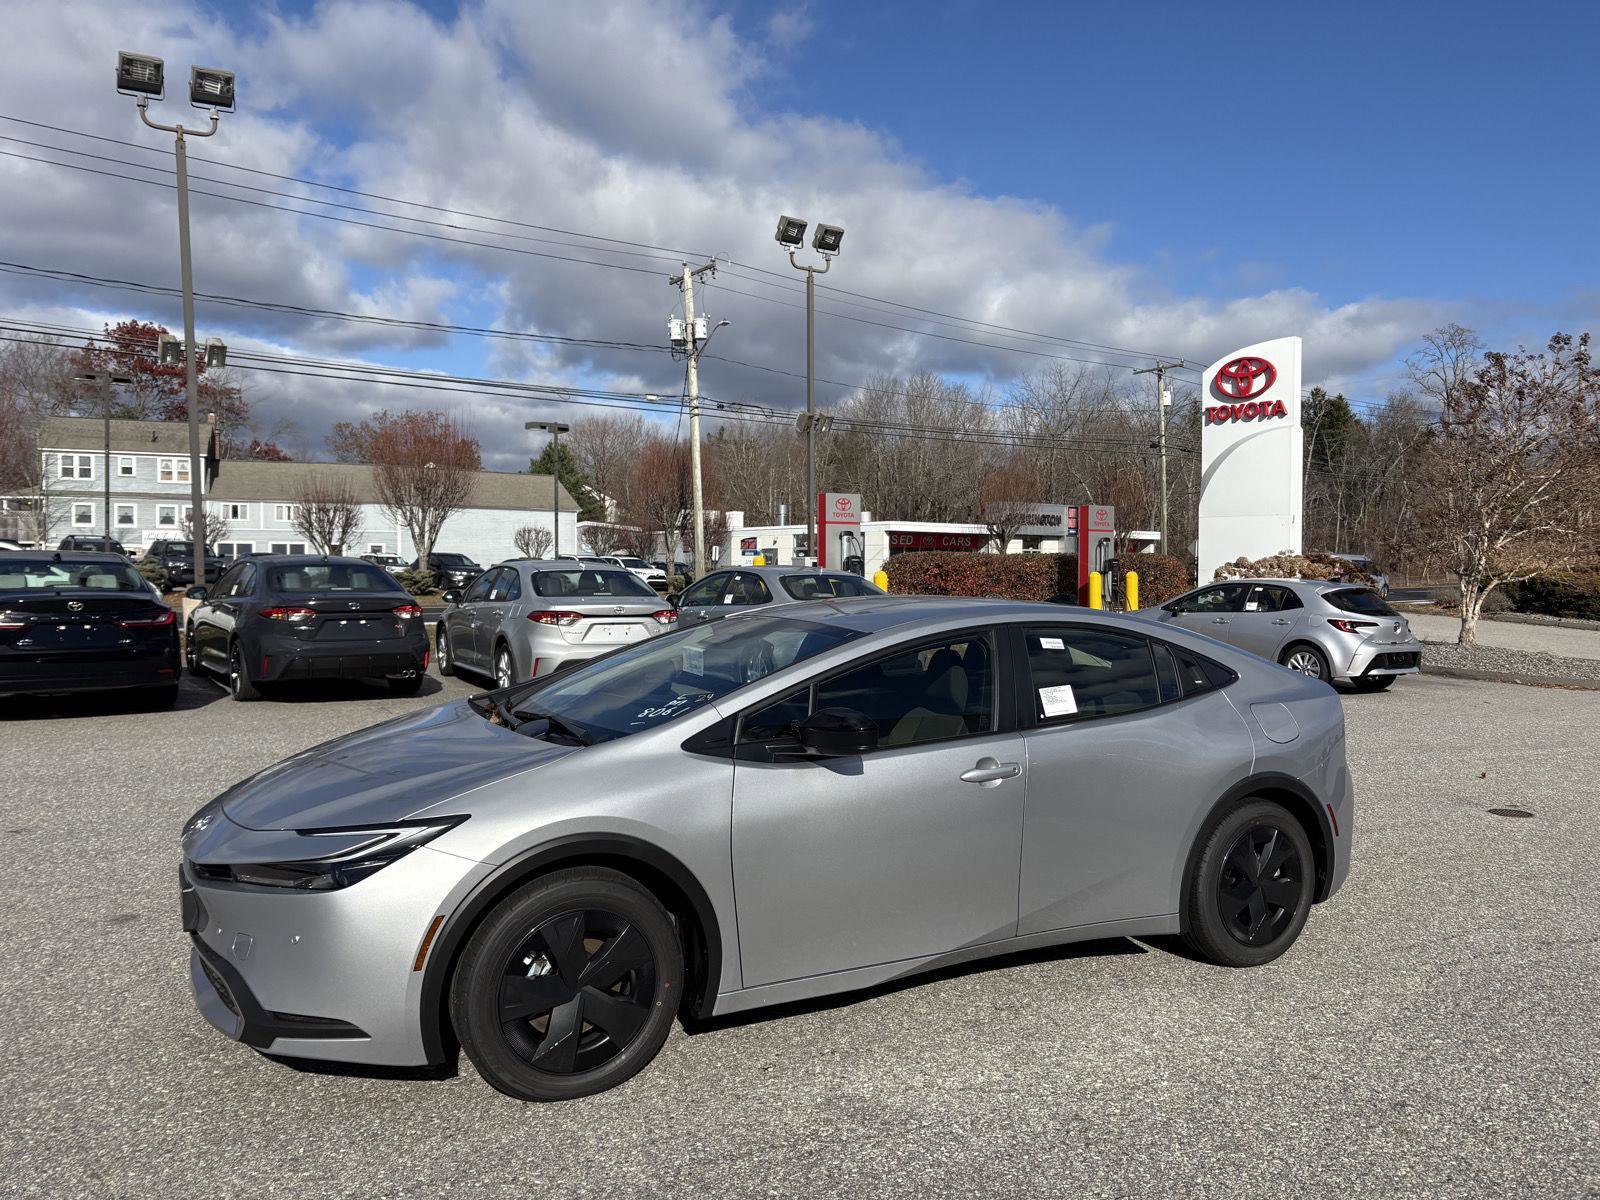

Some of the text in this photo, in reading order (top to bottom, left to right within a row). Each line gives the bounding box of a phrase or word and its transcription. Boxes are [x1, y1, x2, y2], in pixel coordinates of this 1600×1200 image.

[1205, 399, 1288, 424] TOYOTA
[891, 534, 971, 547] SED CARS
